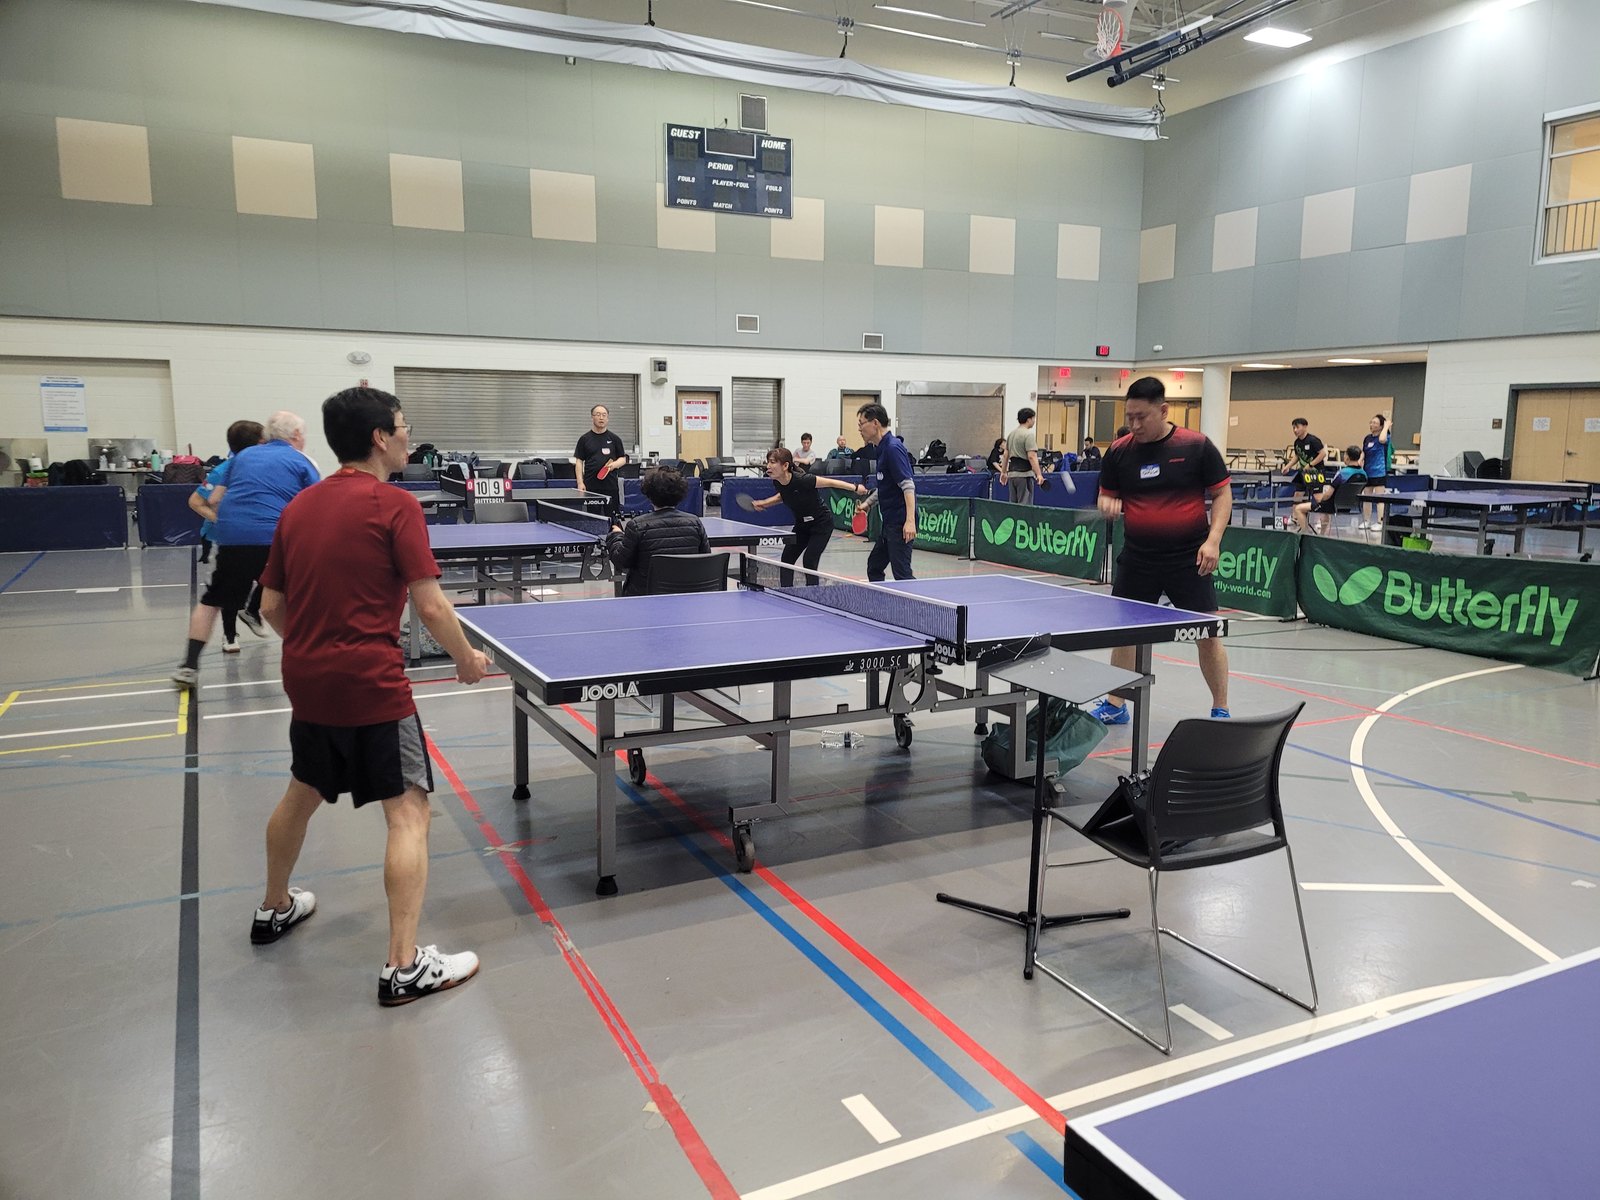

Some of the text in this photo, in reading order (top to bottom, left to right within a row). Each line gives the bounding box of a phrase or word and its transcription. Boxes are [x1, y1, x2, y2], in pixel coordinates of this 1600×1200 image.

[670, 127, 701, 140] GUEST
[761, 139, 787, 150] HOME
[707, 161, 734, 171] PERIOD
[677, 175, 696, 183] FOULS
[712, 179, 750, 189] PLAYER-FOUL
[765, 184, 783, 192] FOULS
[676, 198, 697, 206] POINTS
[764, 207, 783, 215] POINTS
[467, 481, 473, 490] 0
[476, 480, 488, 495] 10
[493, 480, 500, 495] 9
[505, 481, 511, 490] 0
[917, 506, 959, 539] tterfly
[1275, 518, 1283, 527] 25
[758, 537, 785, 546] JOOLA
[916, 533, 957, 545] tterfly-world.com
[1015, 519, 1098, 563] Butterfly
[572, 545, 581, 553] SC
[1211, 546, 1279, 589] erfly
[1213, 580, 1272, 599] rfly-world.com
[1383, 570, 1579, 645] Butterfly
[1174, 620, 1225, 642] JOOLA 2
[934, 642, 957, 659] JOOLA
[859, 656, 885, 670] 3000
[890, 654, 902, 667] SC
[580, 681, 640, 702] JOOLA
